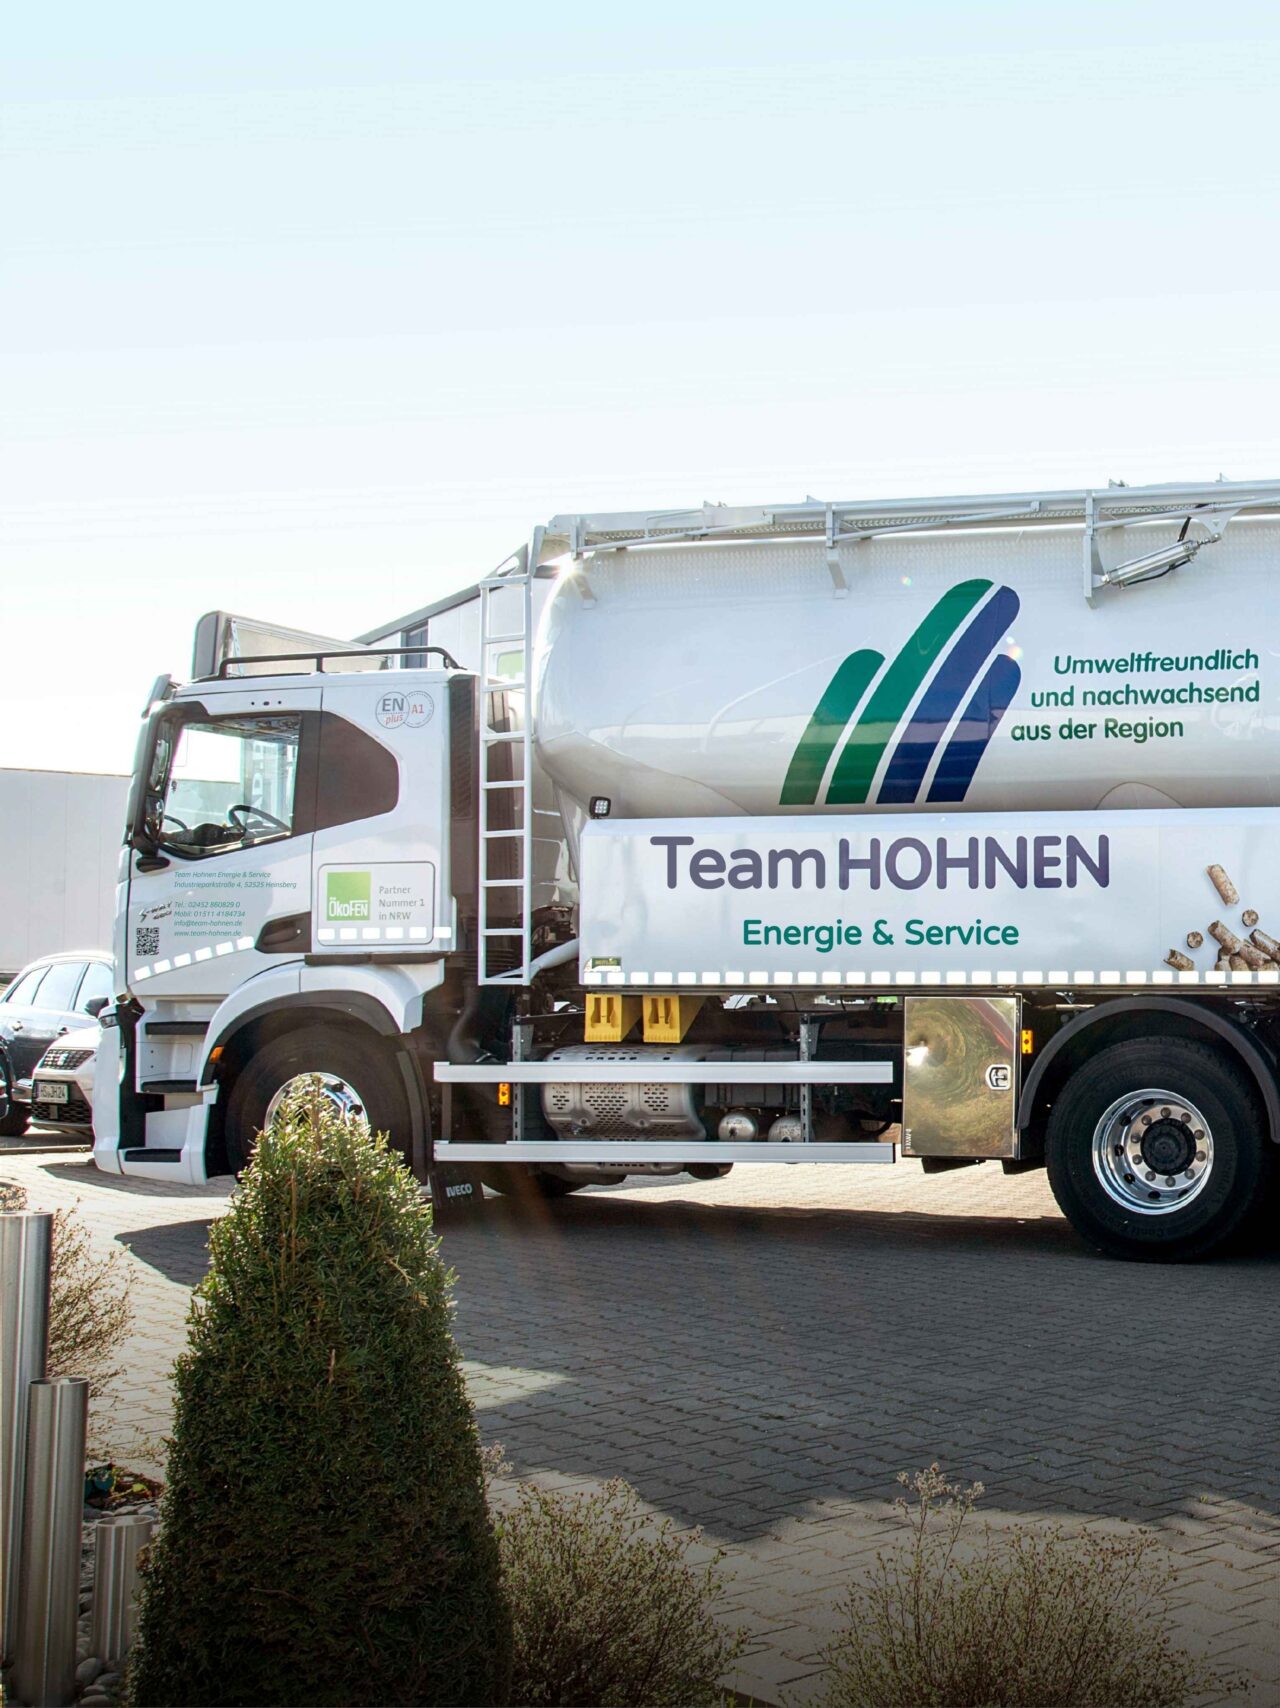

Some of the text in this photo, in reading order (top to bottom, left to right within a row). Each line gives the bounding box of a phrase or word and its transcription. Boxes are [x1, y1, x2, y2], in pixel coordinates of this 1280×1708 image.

[1053, 648, 1259, 675] Umweltfreundlich
[1030, 680, 1260, 708] und nachwachsend
[382, 697, 405, 712] EN
[411, 703, 425, 714] A1
[1010, 716, 1184, 744] aus der Region
[649, 834, 1110, 891] Team HOHNEN
[217, 871, 242, 879] Energie
[265, 881, 297, 889] Heinsberg
[378, 886, 412, 895] Partner
[378, 898, 425, 908] Nummer 1
[378, 911, 412, 921] in NRW
[742, 918, 1020, 954] Energie & Service
[446, 1183, 473, 1198] IVECO
